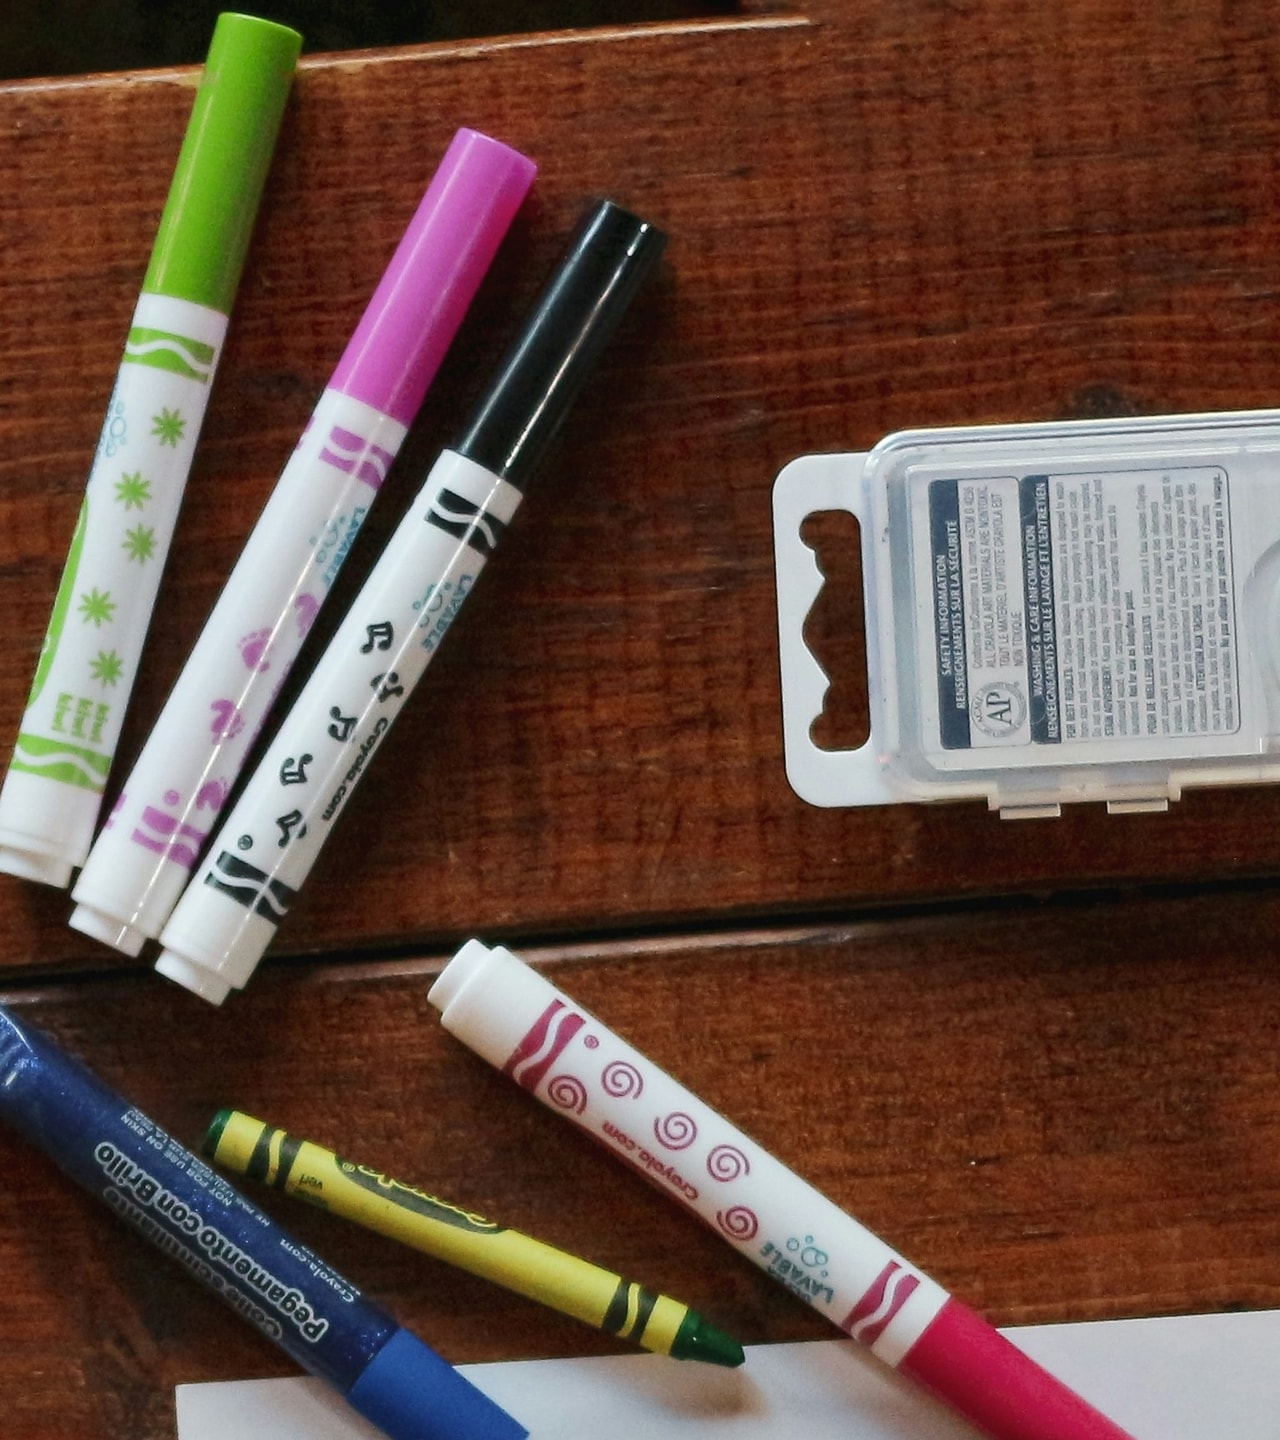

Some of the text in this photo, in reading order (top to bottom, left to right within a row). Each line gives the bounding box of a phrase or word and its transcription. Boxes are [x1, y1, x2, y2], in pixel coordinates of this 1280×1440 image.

[949, 573, 960, 586] LA
[1039, 549, 1050, 561] ET
[1040, 563, 1051, 603] LAVAGE
[418, 572, 475, 652] LAVABLE
[936, 554, 951, 675] SAFETY INFORMATION
[949, 590, 961, 611] SUR
[983, 596, 993, 611] ART
[984, 613, 995, 650] CRAYOLA
[1025, 525, 1042, 695] WASHING & CARE INFORMATION
[1041, 606, 1052, 618] LE
[1042, 620, 1053, 642] SUR
[950, 612, 965, 708] RENSEIGNEMENTS
[1043, 644, 1057, 738] RENSEIGNEMENTS
[985, 690, 1012, 726] AP
[317, 714, 390, 823] Crayola.com
[85, 1136, 165, 1209] Brillo
[119, 1113, 232, 1207] NOT FOR USE ON SKIN
[598, 1117, 701, 1203] Crayola.com
[151, 1187, 206, 1238] con
[190, 1219, 334, 1344] Pegamento
[276, 1235, 358, 1305] Crayola.com
[757, 1238, 837, 1307] LAVABLE
